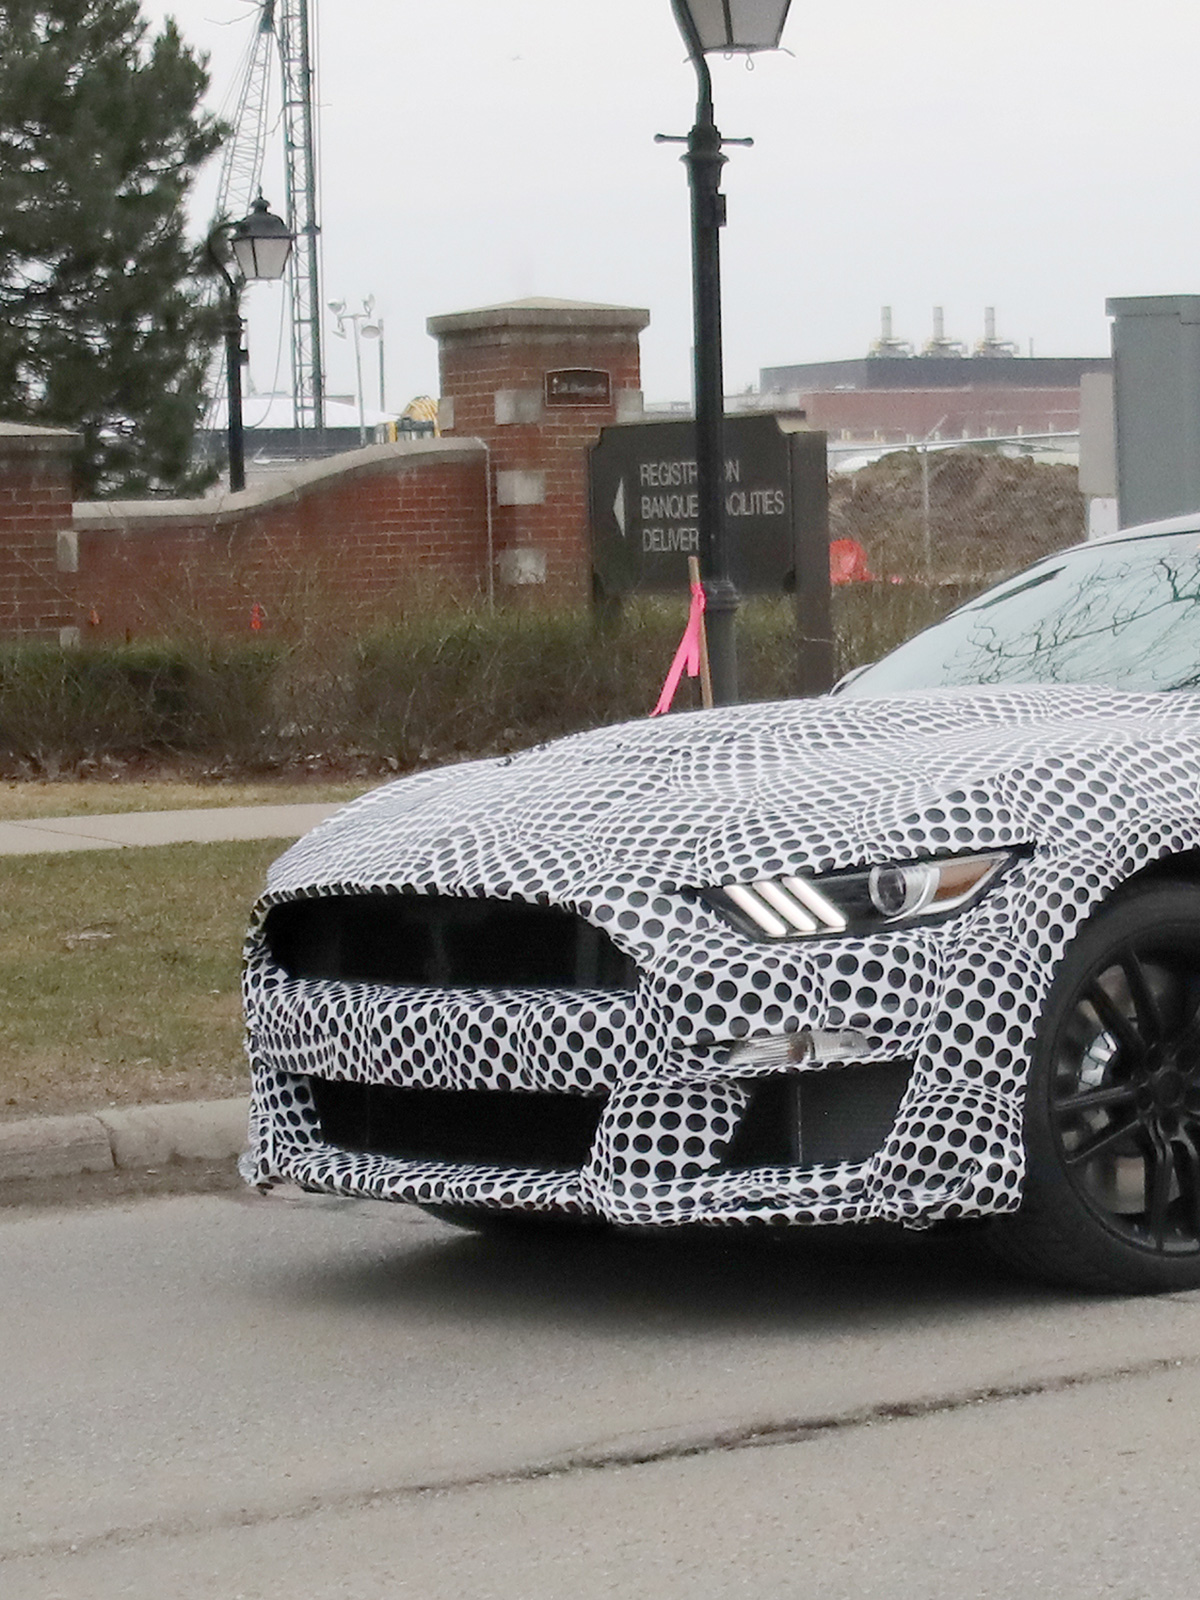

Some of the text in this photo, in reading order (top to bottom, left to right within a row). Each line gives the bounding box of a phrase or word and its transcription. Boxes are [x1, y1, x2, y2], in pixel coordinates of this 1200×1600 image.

[641, 490, 785, 519] BANQUE CILITIES
[642, 526, 700, 552] DELIVER
